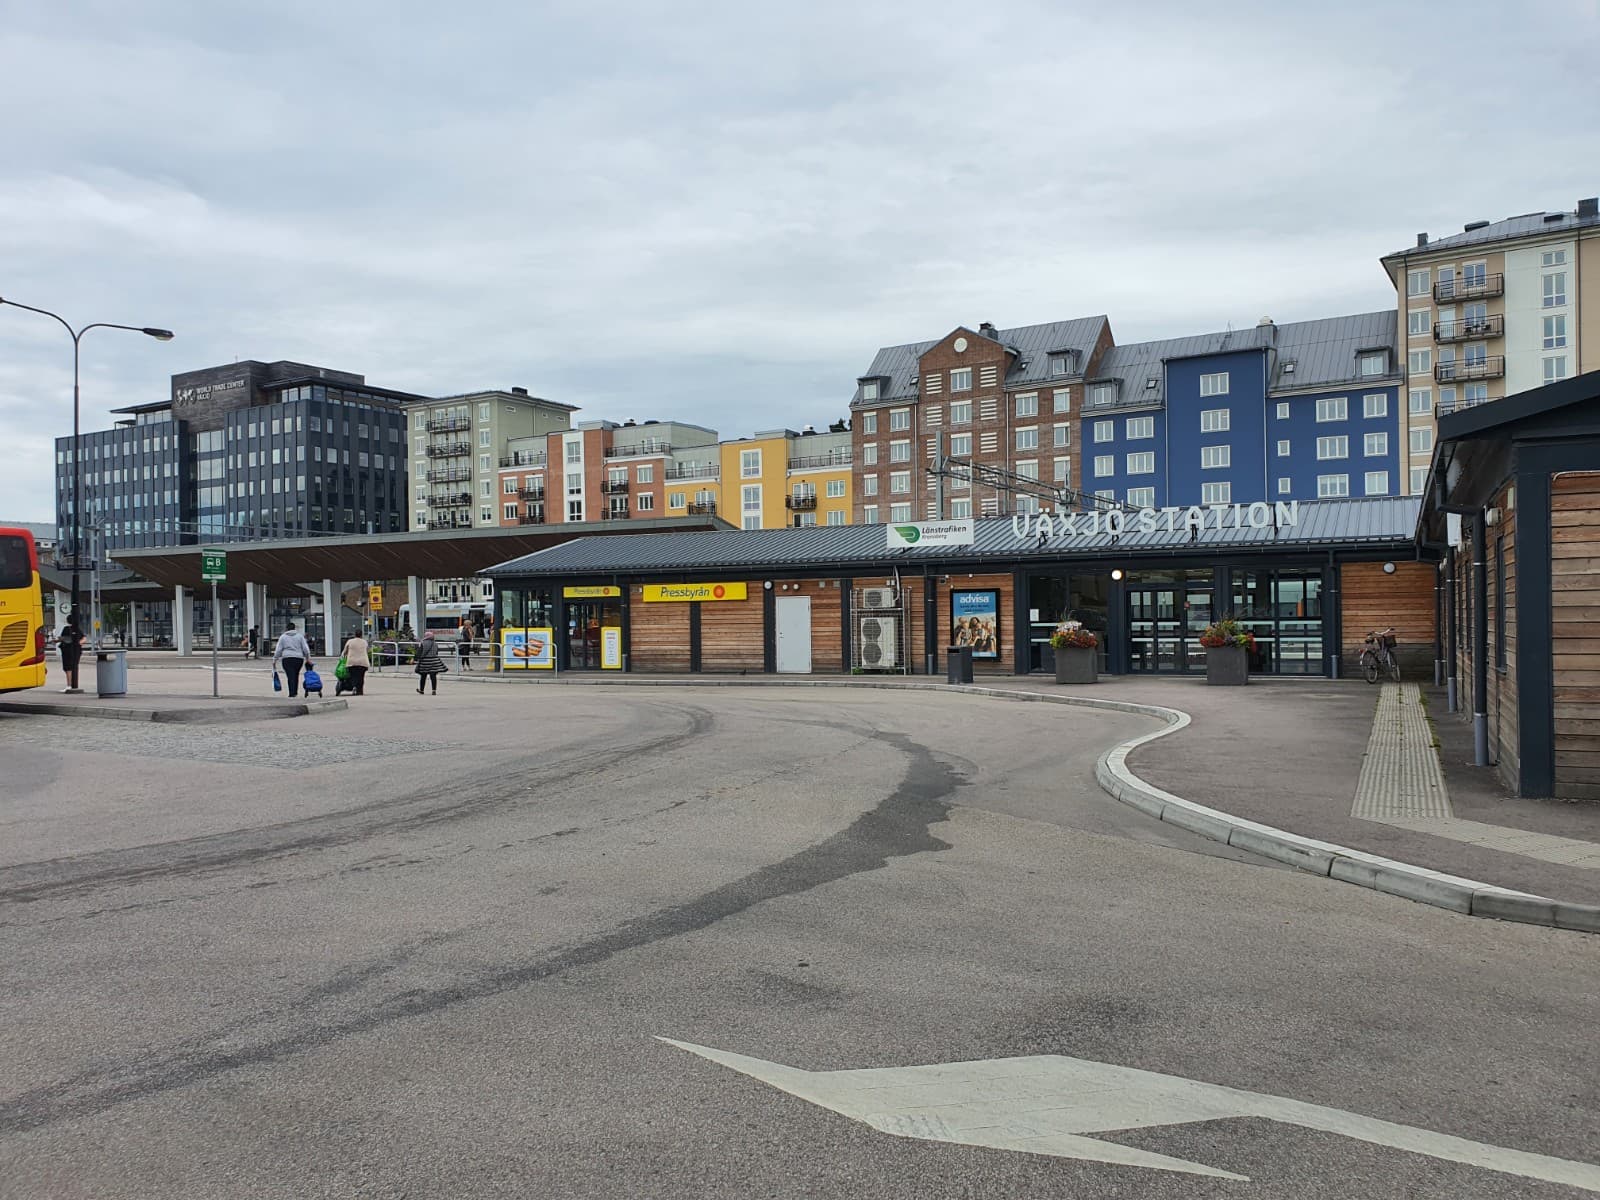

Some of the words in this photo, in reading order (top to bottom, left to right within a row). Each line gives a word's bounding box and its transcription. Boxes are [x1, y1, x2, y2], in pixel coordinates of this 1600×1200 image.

[1012, 503, 1126, 539] VÄXJÖ
[1139, 500, 1298, 533] STATION
[922, 525, 967, 534] Länstrafiken
[215, 557, 221, 567] B
[660, 586, 710, 599] Pressbyrån
